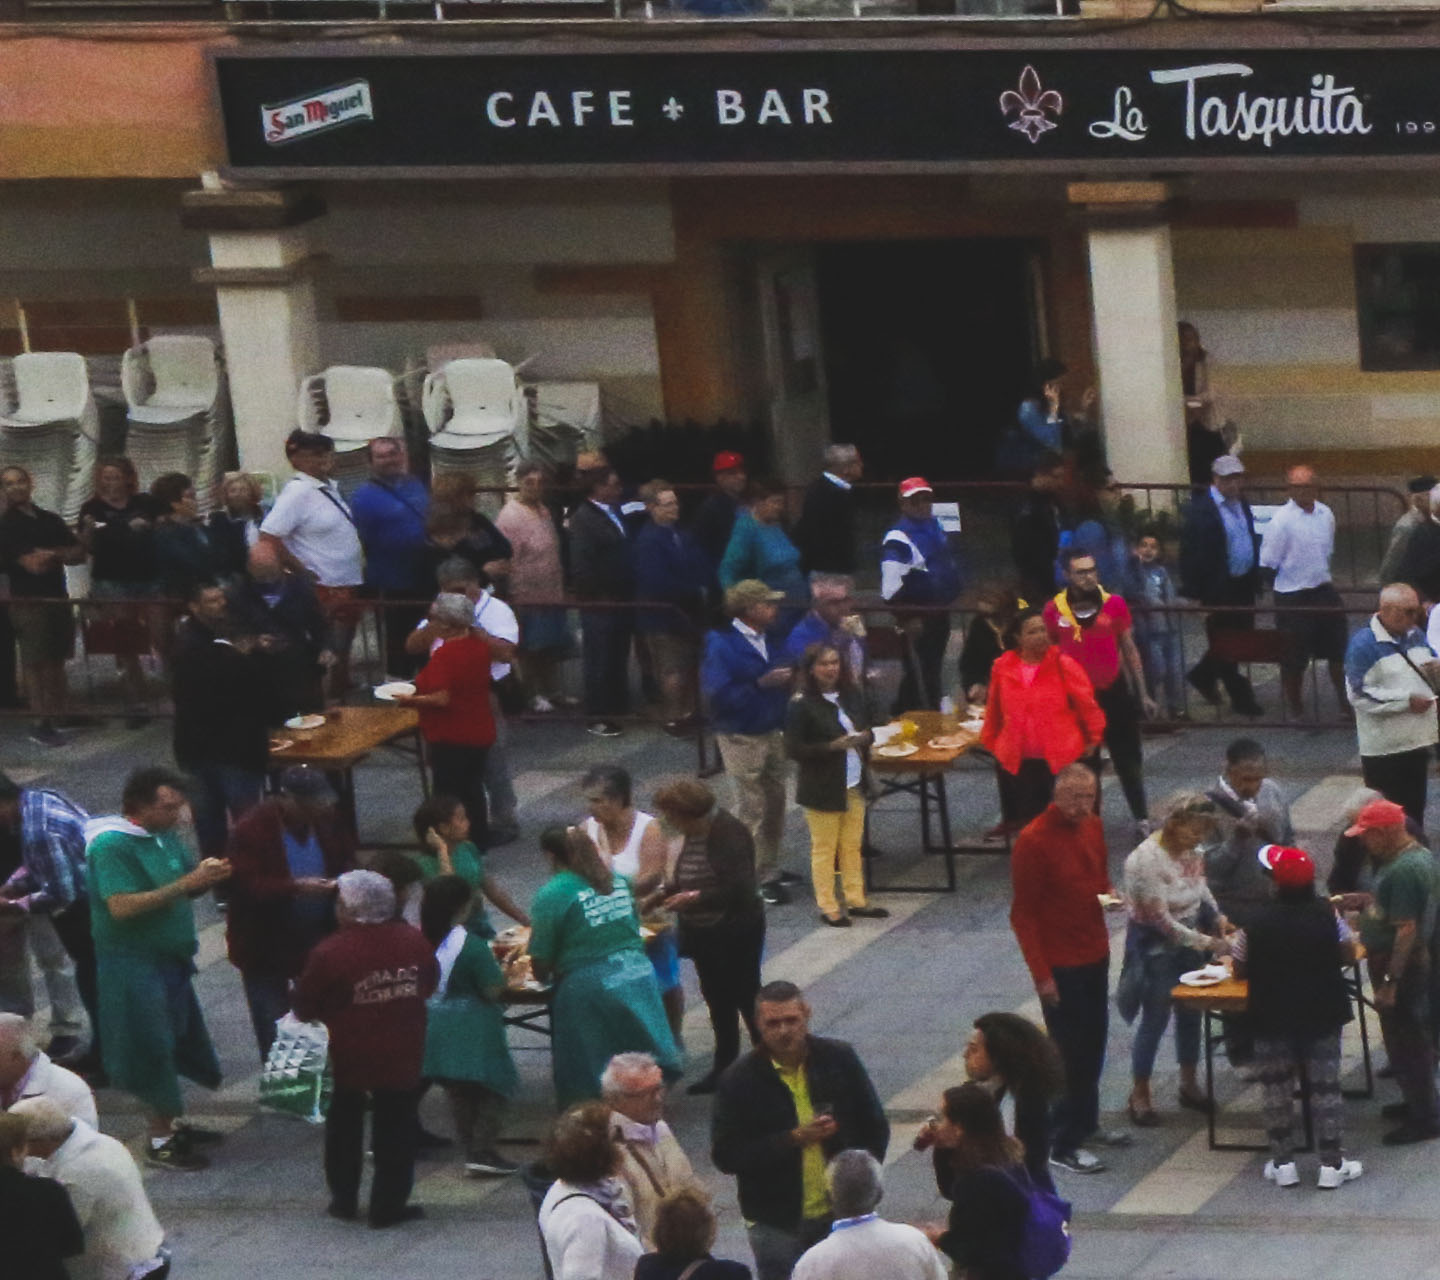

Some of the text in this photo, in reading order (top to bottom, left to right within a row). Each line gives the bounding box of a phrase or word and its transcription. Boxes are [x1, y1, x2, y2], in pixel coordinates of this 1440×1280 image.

[267, 89, 363, 141] San Miguel
[486, 88, 833, 128] CAFE BAR
[1088, 62, 1373, 148] La Tasquita
